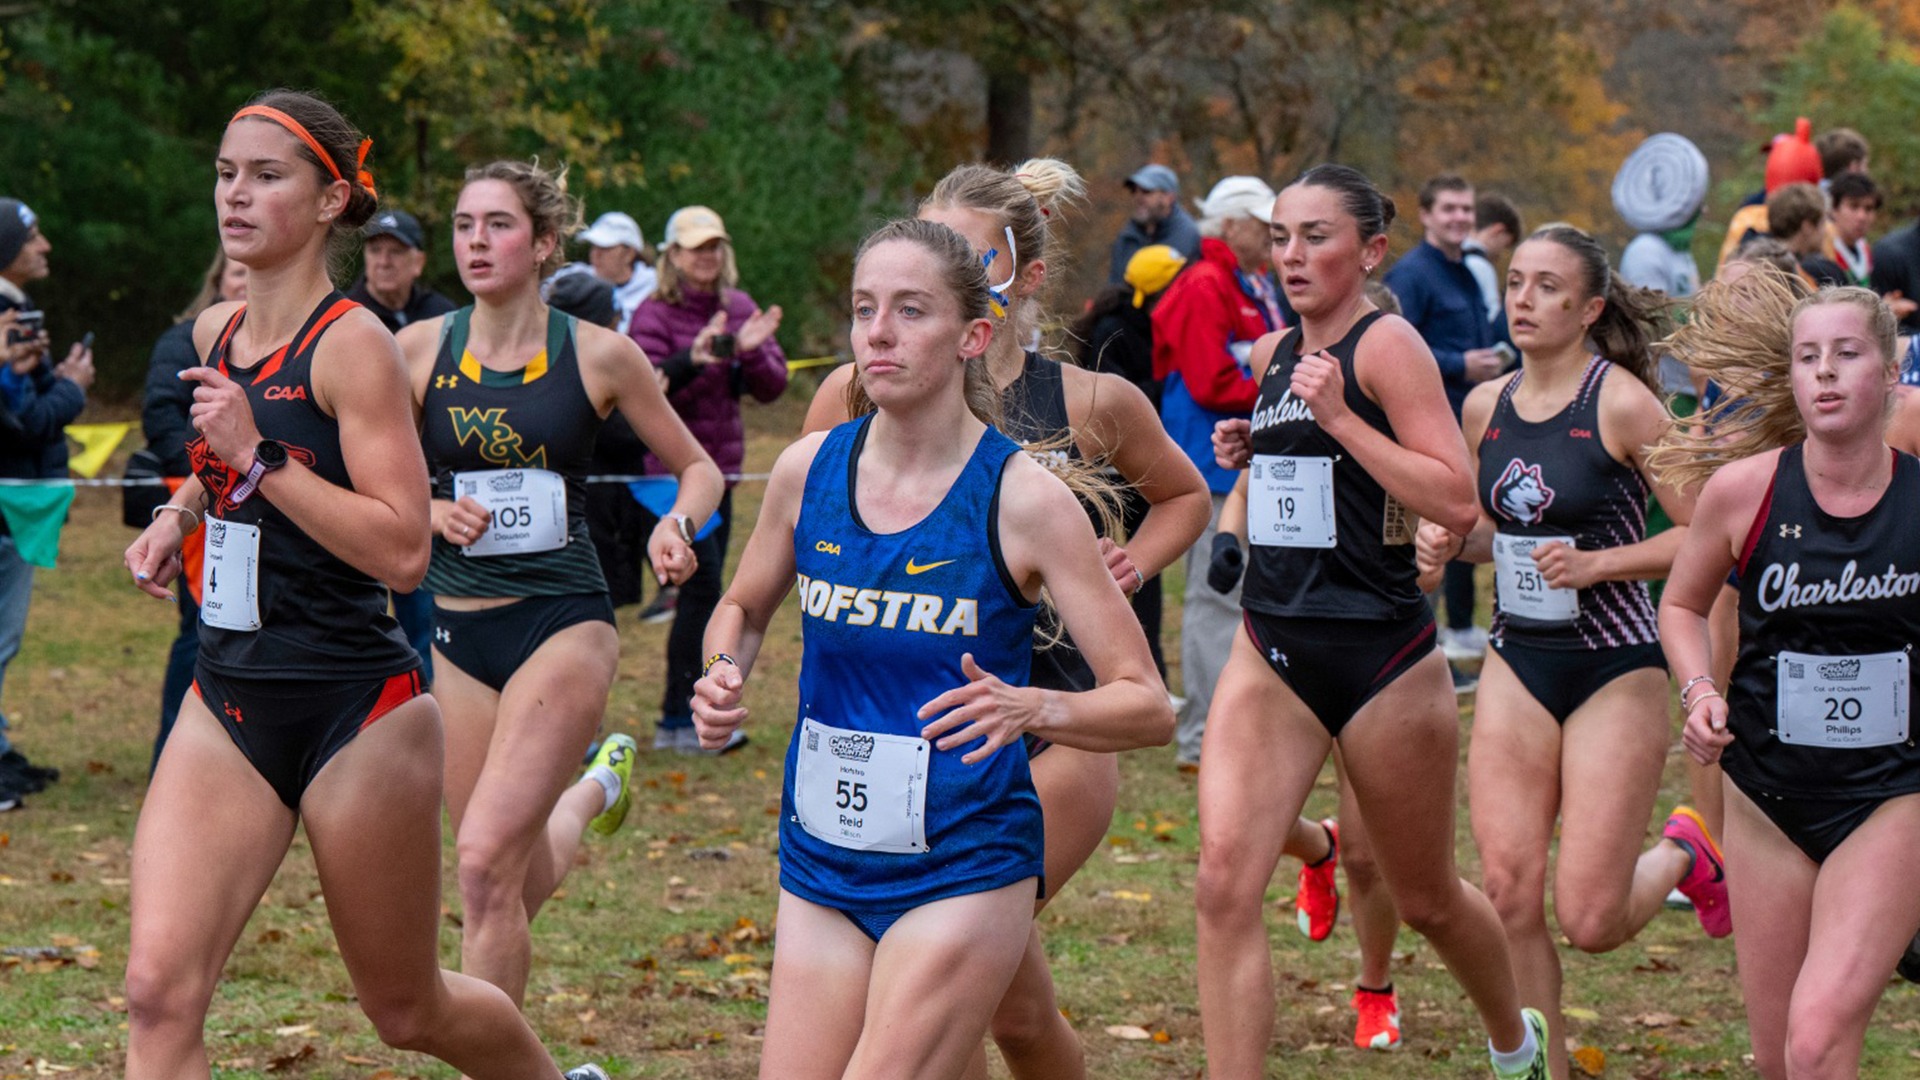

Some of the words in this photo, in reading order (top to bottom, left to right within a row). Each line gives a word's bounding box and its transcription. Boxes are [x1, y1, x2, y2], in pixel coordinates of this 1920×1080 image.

[263, 385, 307, 400] CAA
[1277, 496, 1295, 520] 19
[490, 506, 532, 529] 105
[1273, 523, 1302, 533] O'Toole
[815, 540, 842, 556] CAA
[209, 566, 218, 594] 4
[1515, 570, 1543, 592] 251
[797, 573, 978, 637] HOFSTRA
[1839, 658, 1861, 668] CAA
[1836, 685, 1872, 693] Charleston
[1824, 697, 1863, 721] 20
[1825, 725, 1862, 735] Phillips
[850, 734, 875, 744] CAA
[839, 765, 866, 777] Hofstra
[835, 779, 868, 812] 55
[839, 813, 864, 829] Reid
